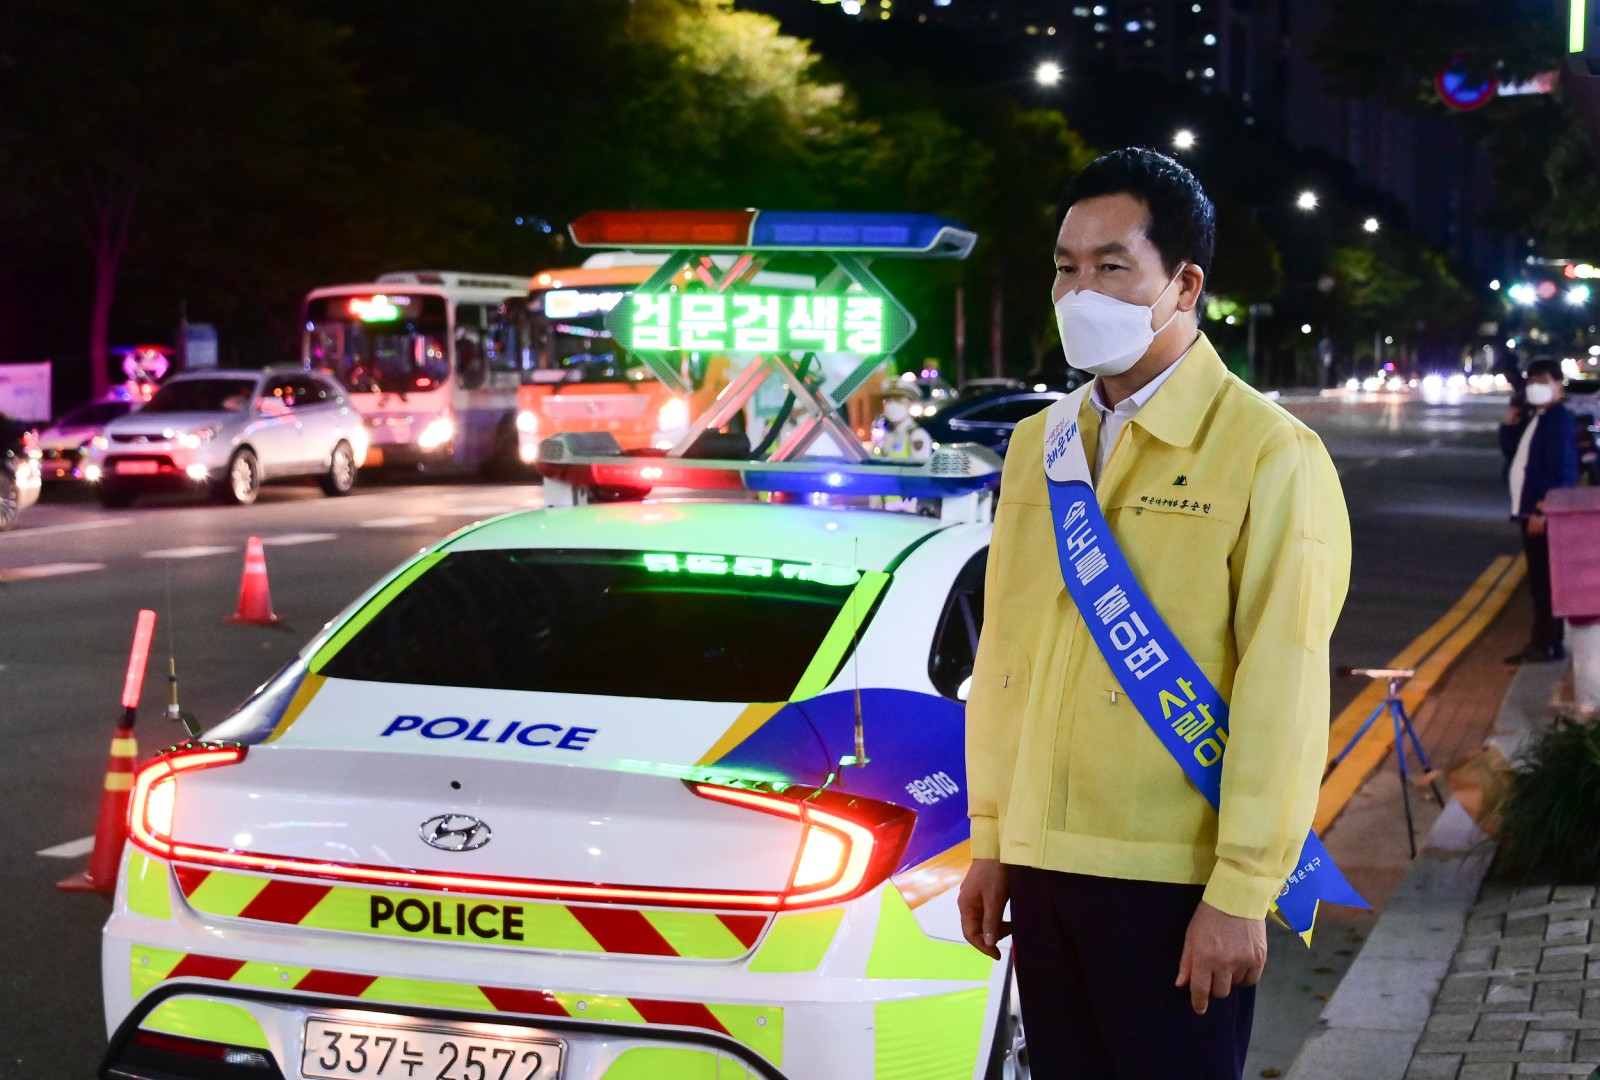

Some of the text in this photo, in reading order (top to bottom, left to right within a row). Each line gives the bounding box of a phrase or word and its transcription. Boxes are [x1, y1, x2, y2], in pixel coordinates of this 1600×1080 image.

[633, 294, 883, 353] 검문검색중
[1046, 422, 1077, 469] 해운대
[1062, 501, 1228, 767] 속도를 줄이면 사람이
[380, 714, 597, 752] POLICE
[370, 895, 525, 941] POLICE
[319, 1030, 543, 1080] 337누 2572
